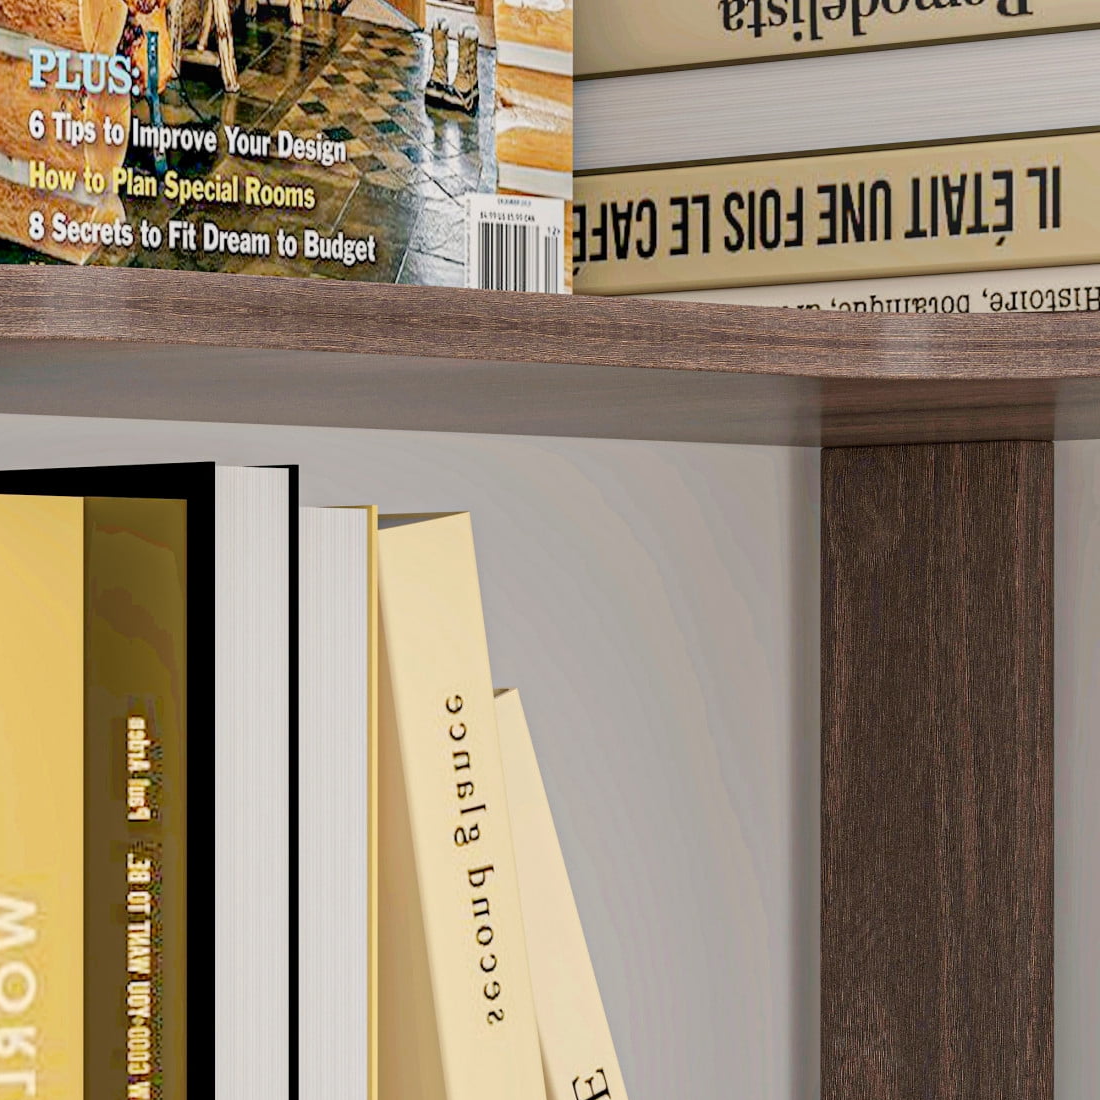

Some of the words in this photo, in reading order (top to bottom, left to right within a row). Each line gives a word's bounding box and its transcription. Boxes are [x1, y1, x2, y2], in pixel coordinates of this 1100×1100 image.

[29, 47, 141, 97] PLUS:
[29, 110, 46, 140] 6
[51, 111, 97, 147] Tips
[103, 116, 125, 146] to
[132, 117, 217, 153] Improve
[224, 125, 271, 157] Your
[277, 130, 347, 166] Design
[29, 160, 77, 191] How
[84, 165, 106, 194] to
[112, 167, 157, 197] Plan
[164, 170, 238, 204] Special
[245, 176, 316, 209] Rooms
[817, 180, 892, 245] UNE
[904, 170, 1013, 247] ÉTAIT
[1026, 166, 1060, 229] IL
[28, 211, 45, 241] 8
[51, 212, 134, 247] Secrets
[140, 219, 162, 248] to
[168, 220, 197, 251] Fit
[203, 222, 271, 256] Dream
[276, 228, 297, 257] to
[303, 229, 376, 266] Budget
[669, 194, 710, 253] LE
[723, 187, 804, 253] FOIS
